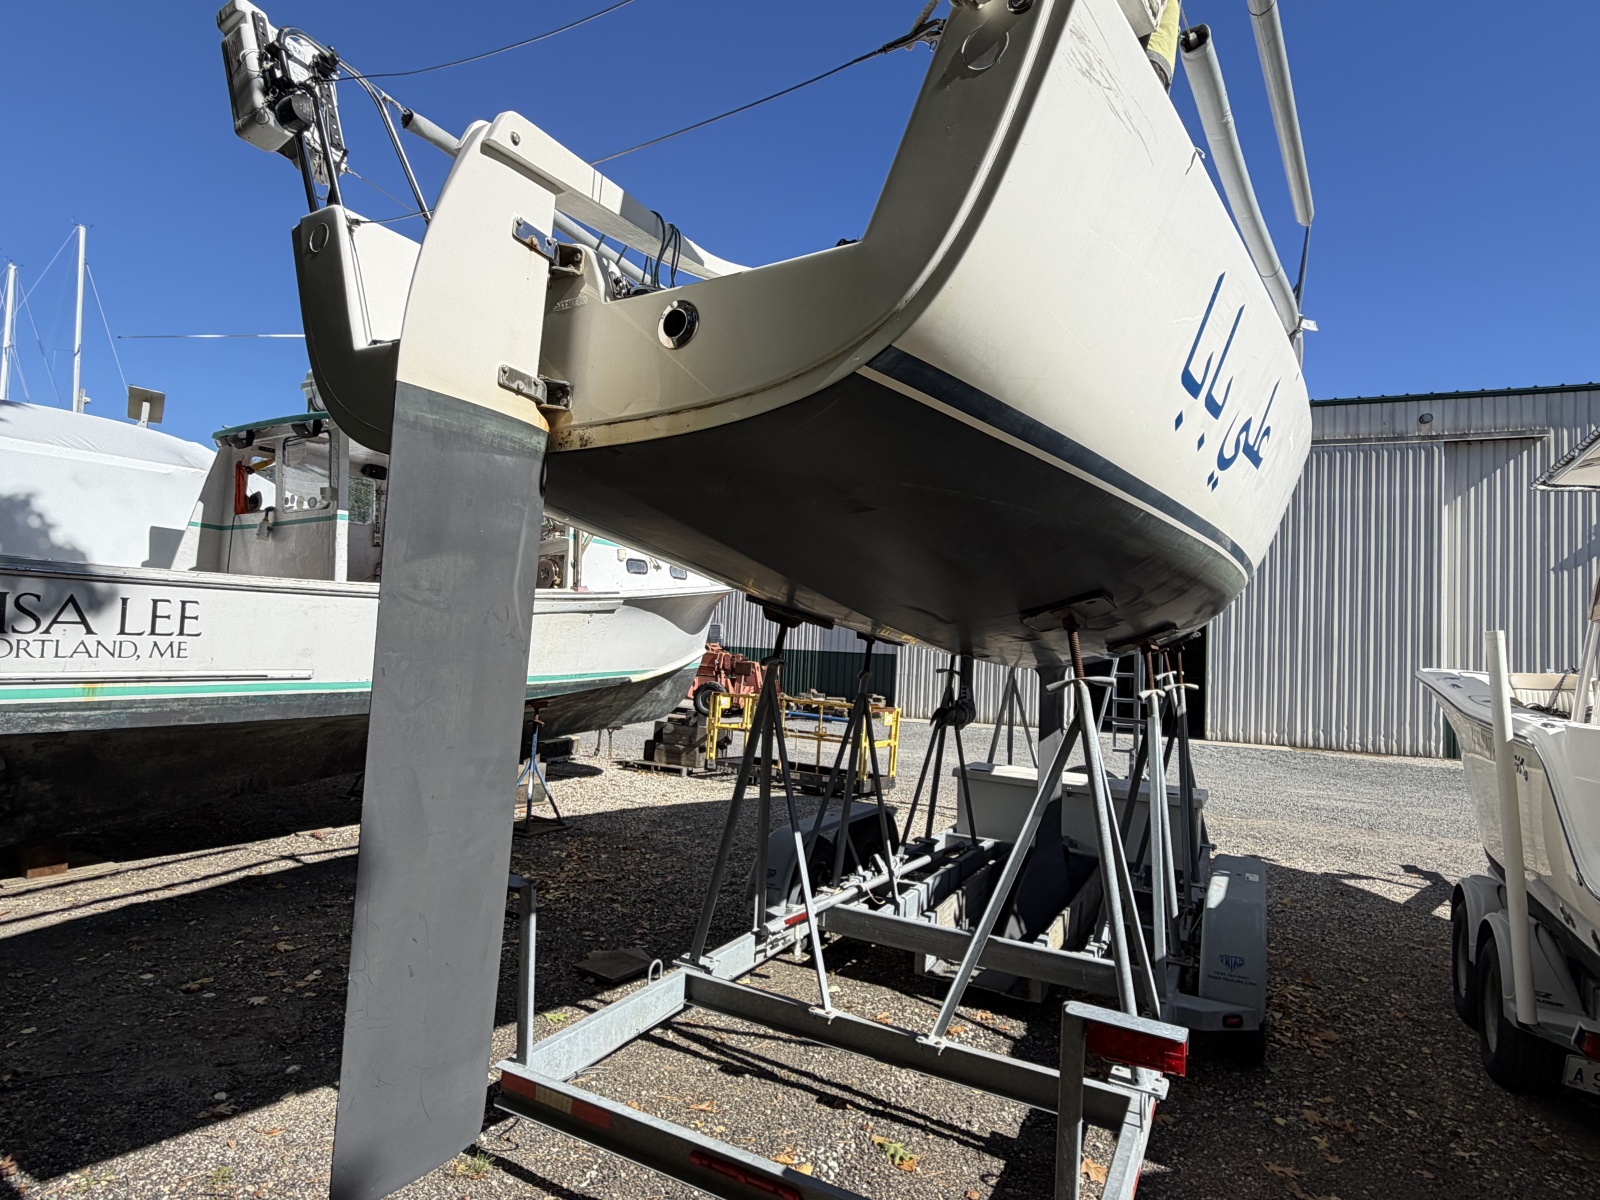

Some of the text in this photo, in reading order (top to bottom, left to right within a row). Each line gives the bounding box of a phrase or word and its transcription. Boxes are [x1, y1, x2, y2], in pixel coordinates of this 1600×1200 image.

[1175, 271, 1282, 493] علي بابا
[116, 597, 203, 637] LEE
[148, 641, 189, 659] ME
[1219, 955, 1245, 970] TRIAD
